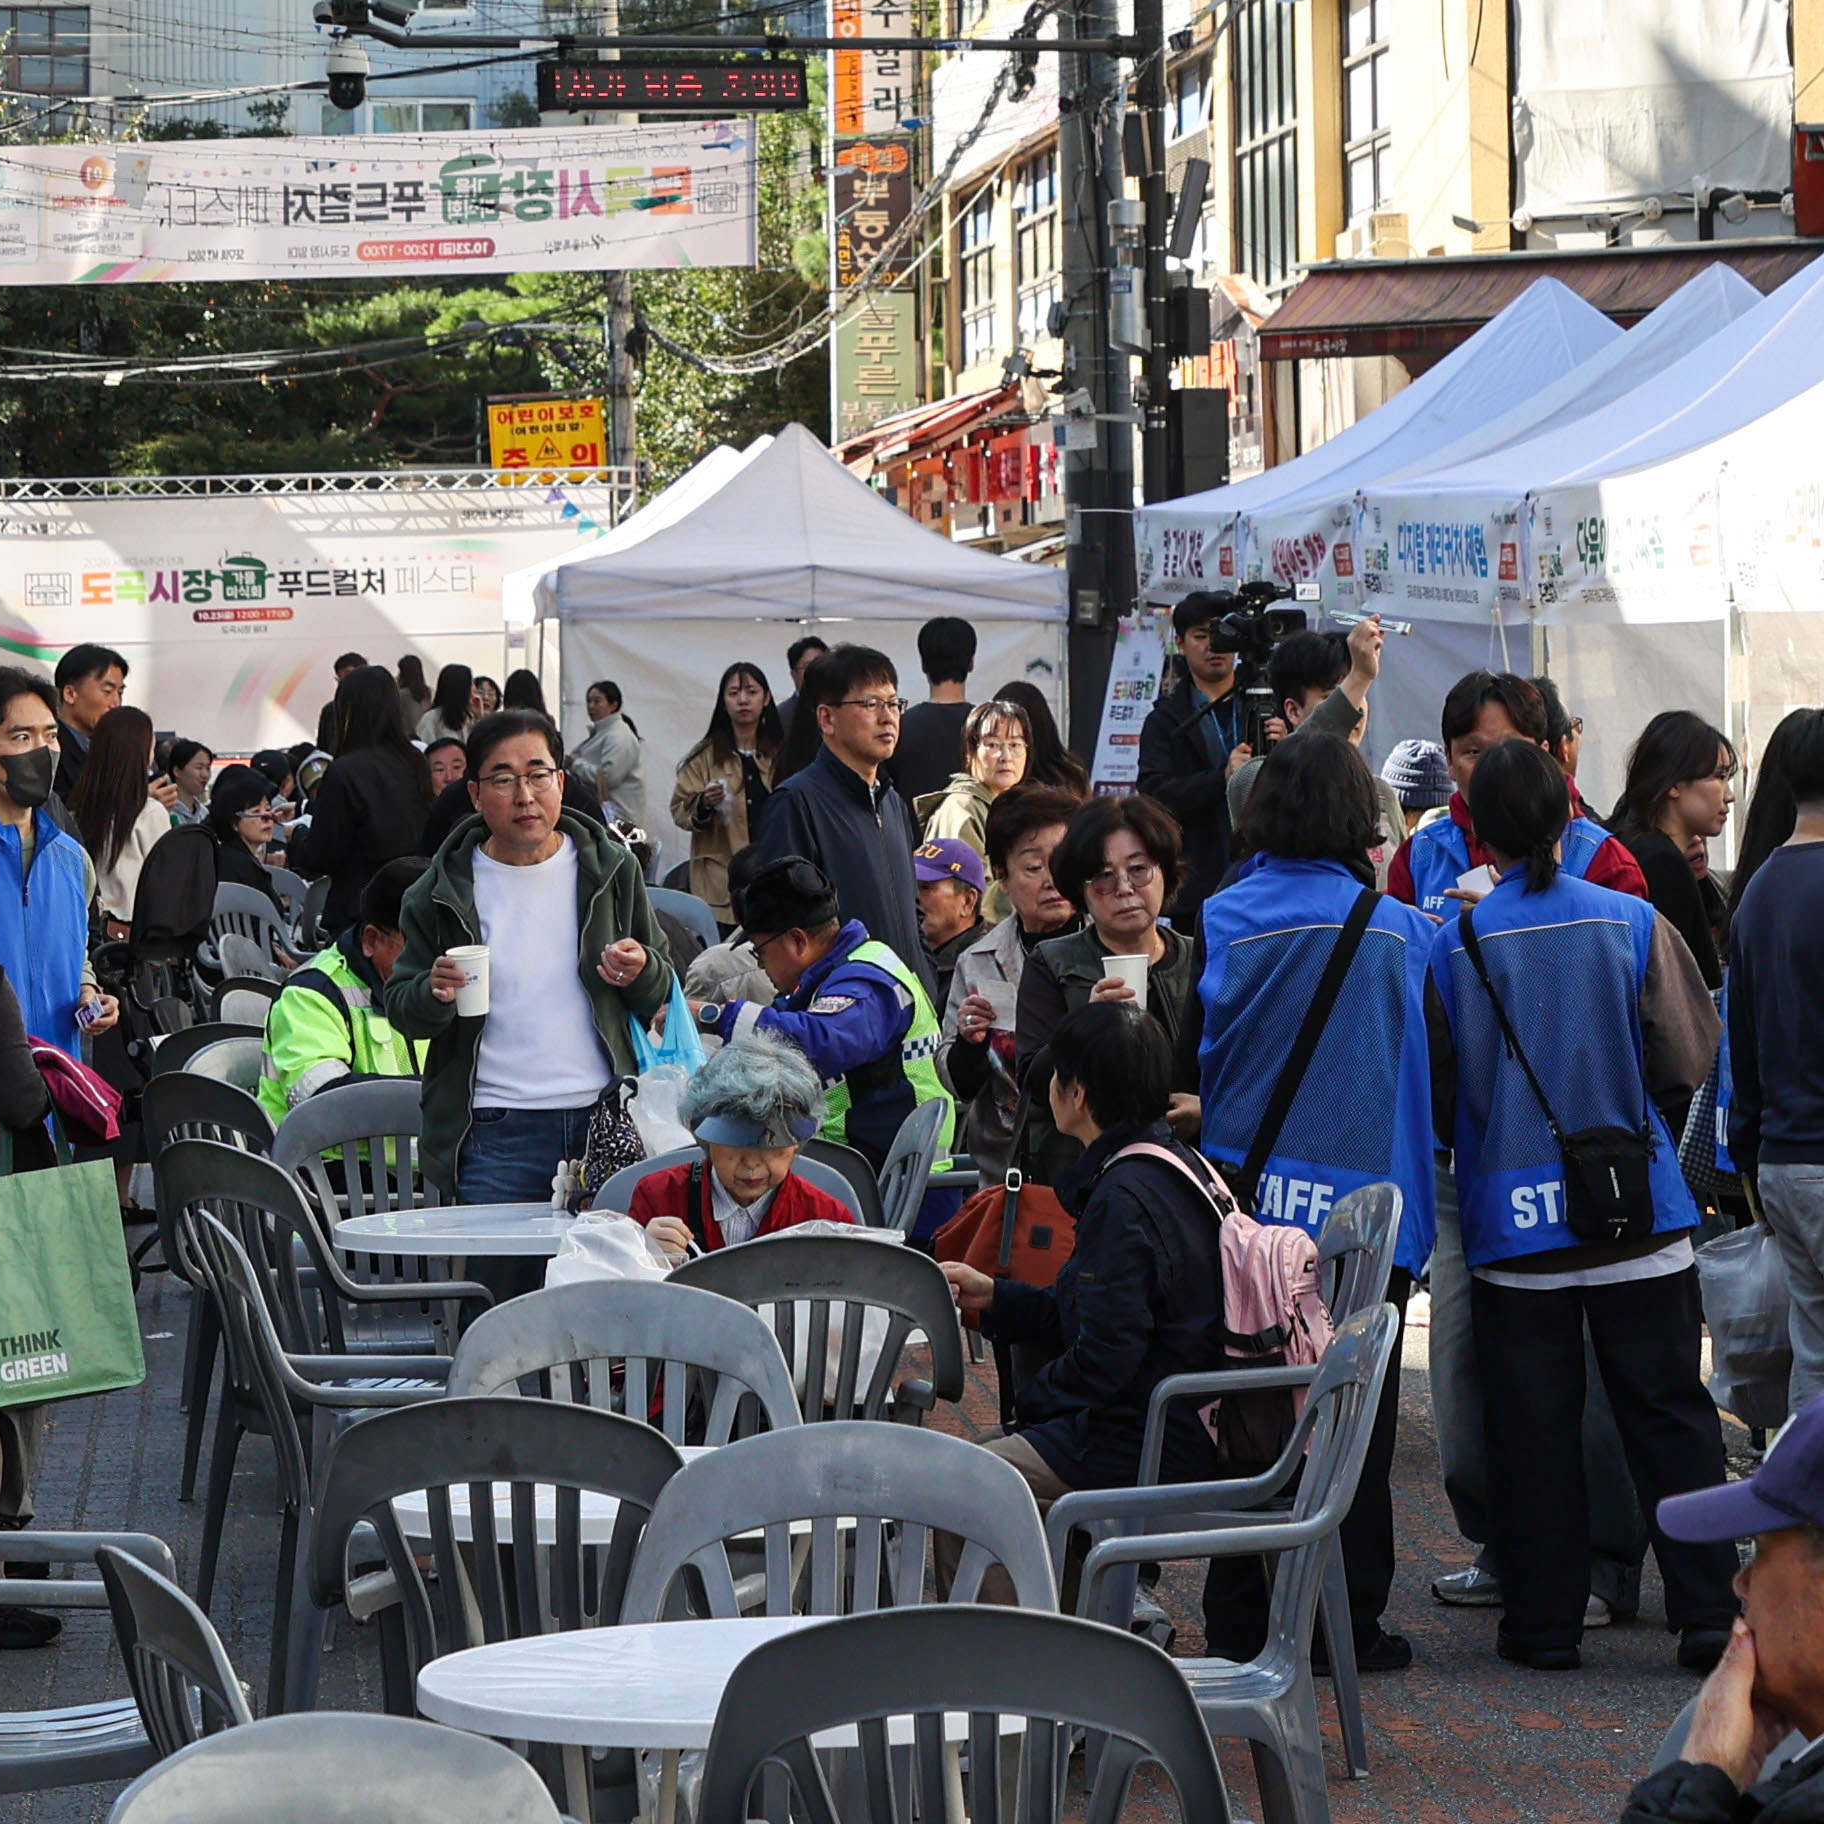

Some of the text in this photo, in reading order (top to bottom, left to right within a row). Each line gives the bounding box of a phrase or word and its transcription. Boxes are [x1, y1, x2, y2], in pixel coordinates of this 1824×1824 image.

[1398, 521, 1426, 575] 디지털
[1465, 523, 1489, 579] 체험
[80, 568, 211, 604] 도곡시장
[276, 566, 477, 597] 푸드컬처 페스타
[0, 1352, 69, 1380] GREEN
